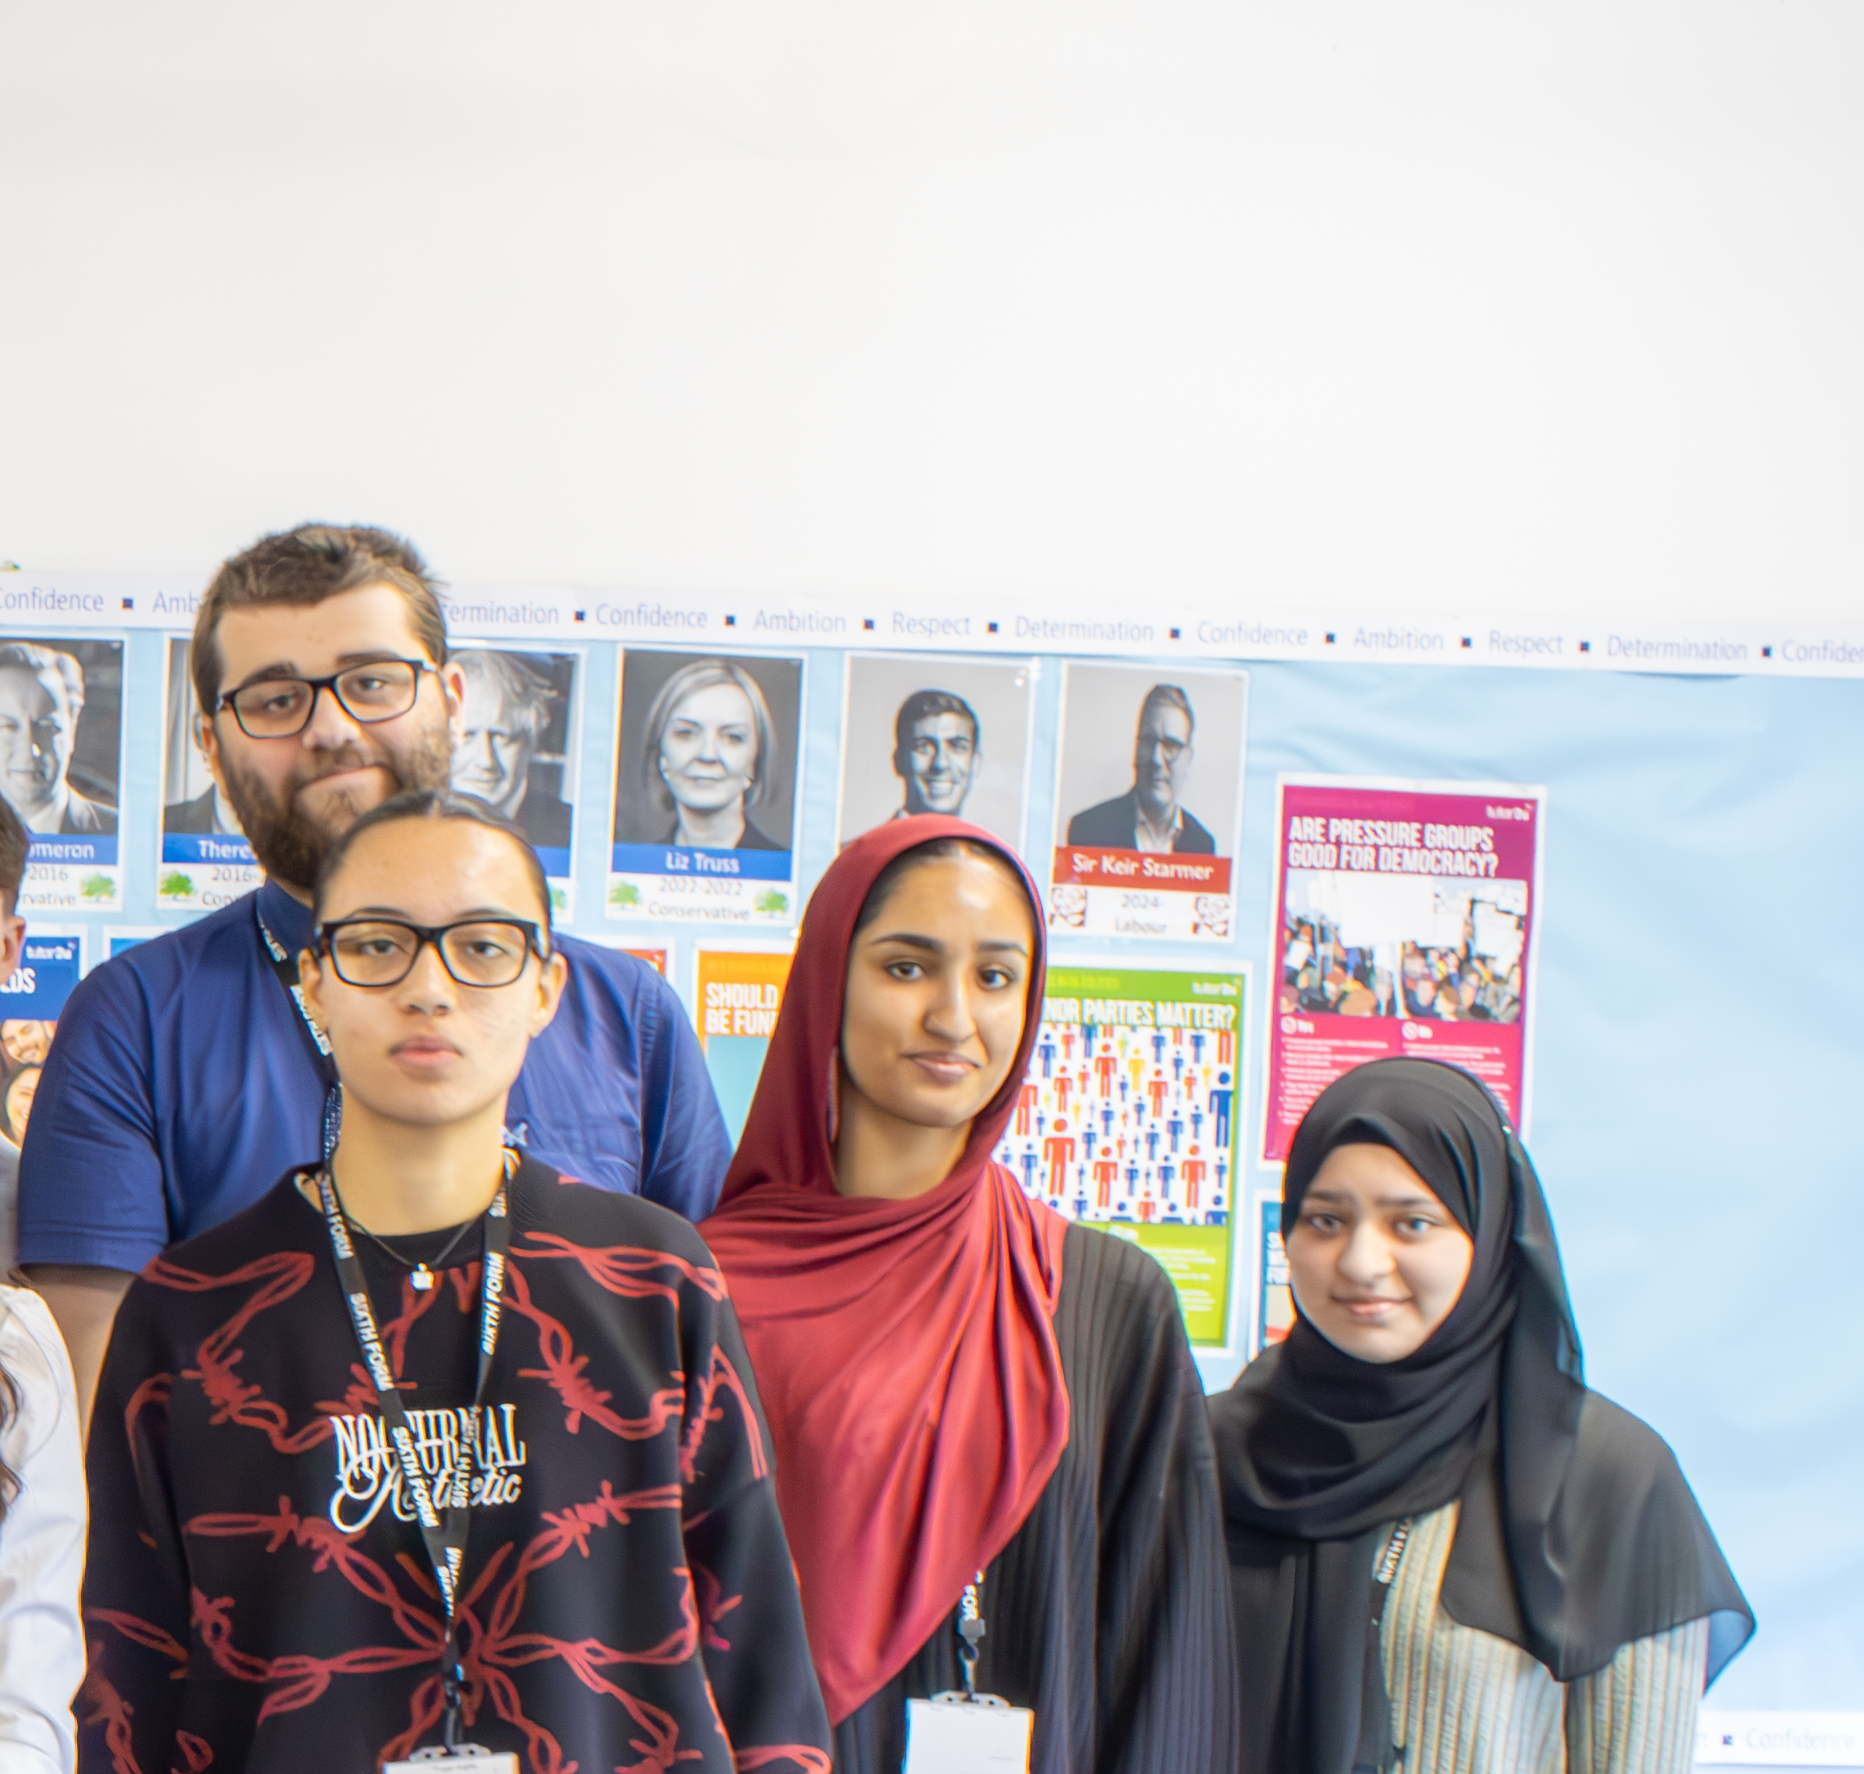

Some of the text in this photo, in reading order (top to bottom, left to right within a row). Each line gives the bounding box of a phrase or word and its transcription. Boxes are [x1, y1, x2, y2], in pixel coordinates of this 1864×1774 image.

[596, 605, 707, 628] Confidence
[755, 608, 845, 631] Ambition
[893, 611, 970, 639] Respect
[1016, 616, 1153, 640] Determination
[1198, 621, 1307, 645] Confidence
[1355, 627, 1442, 650] Ambition
[1490, 631, 1562, 657] Respect
[1608, 636, 1748, 660] Determination
[1288, 815, 1494, 852] ARE PRESSURE GROUPS
[666, 852, 739, 875] Liz Truss
[1072, 852, 1214, 881] Sir Keir Starmer
[1287, 844, 1499, 878] GOOD FOR DEMOCRACY?
[659, 878, 743, 897] 2022-2022
[648, 902, 750, 922] Conservative
[1114, 917, 1167, 935] Labour
[705, 981, 779, 1009] SHOULD
[705, 1009, 730, 1035] BE
[1083, 997, 1236, 1031] PARTIES MATTER?
[480, 1252, 505, 1357] SIXTH FORM
[348, 1292, 394, 1391] SIXTH FORM
